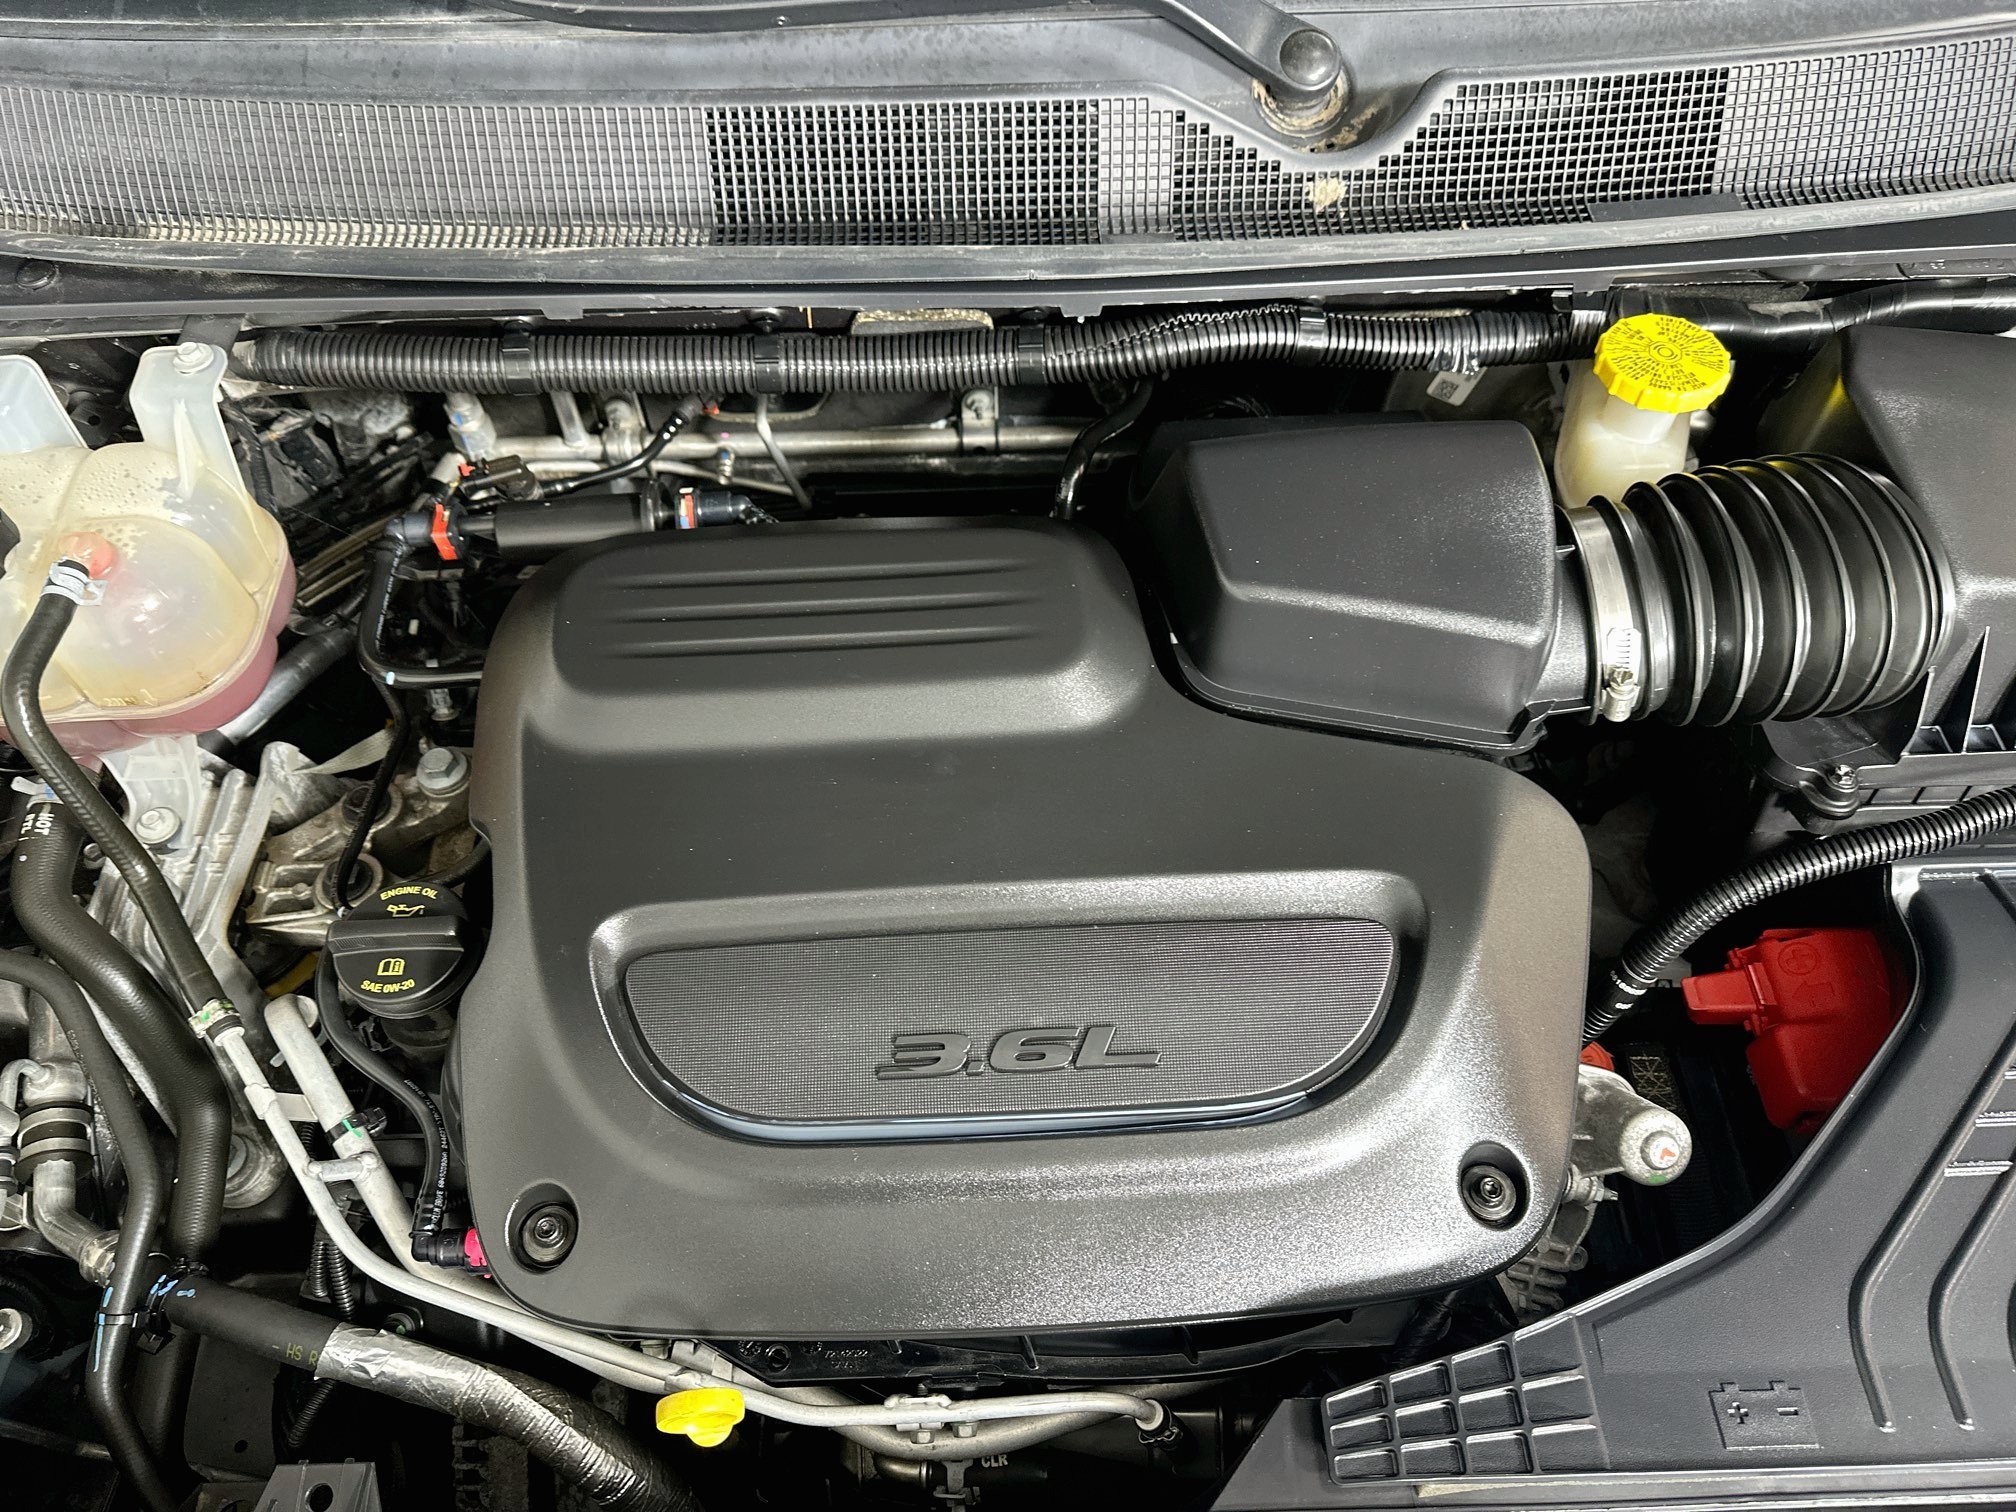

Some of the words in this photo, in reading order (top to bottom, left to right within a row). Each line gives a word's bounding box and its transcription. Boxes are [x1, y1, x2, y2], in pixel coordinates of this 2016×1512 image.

[34, 813, 55, 836] HOT
[380, 886, 422, 901] ENGINE
[421, 887, 438, 900] OIL
[360, 979, 383, 993] SAE
[382, 978, 416, 993] 0W-20
[875, 1025, 1162, 1081] 3.6L
[286, 1342, 304, 1361] HS
[981, 1453, 1009, 1468] CLR
